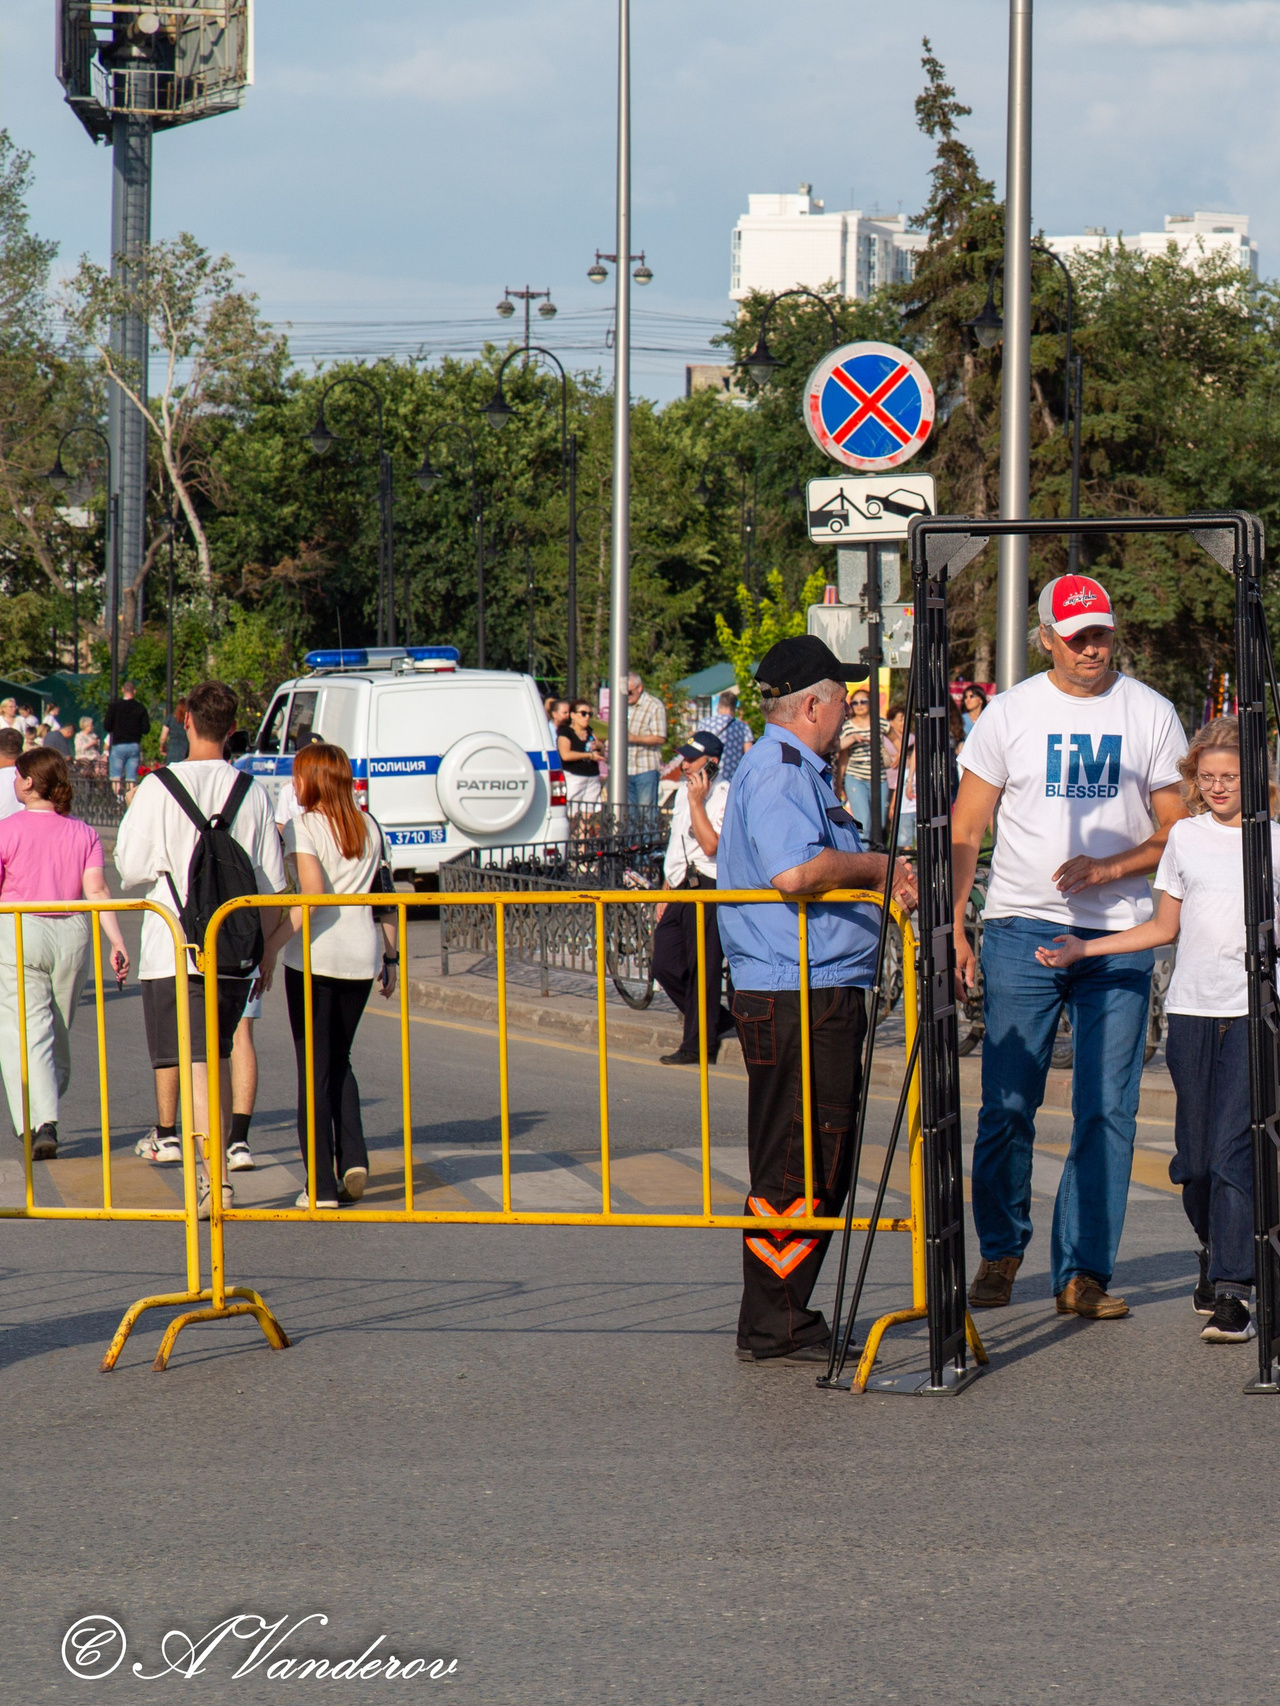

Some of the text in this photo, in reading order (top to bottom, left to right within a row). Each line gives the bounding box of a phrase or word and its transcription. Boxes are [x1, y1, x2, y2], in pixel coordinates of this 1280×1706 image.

[370, 760, 426, 773] ПОЛИЦИЯ
[456, 780, 529, 791] PATRIOT
[1045, 784, 1119, 799] BLESSED
[395, 831, 426, 844] 3710
[431, 829, 444, 840] 55
